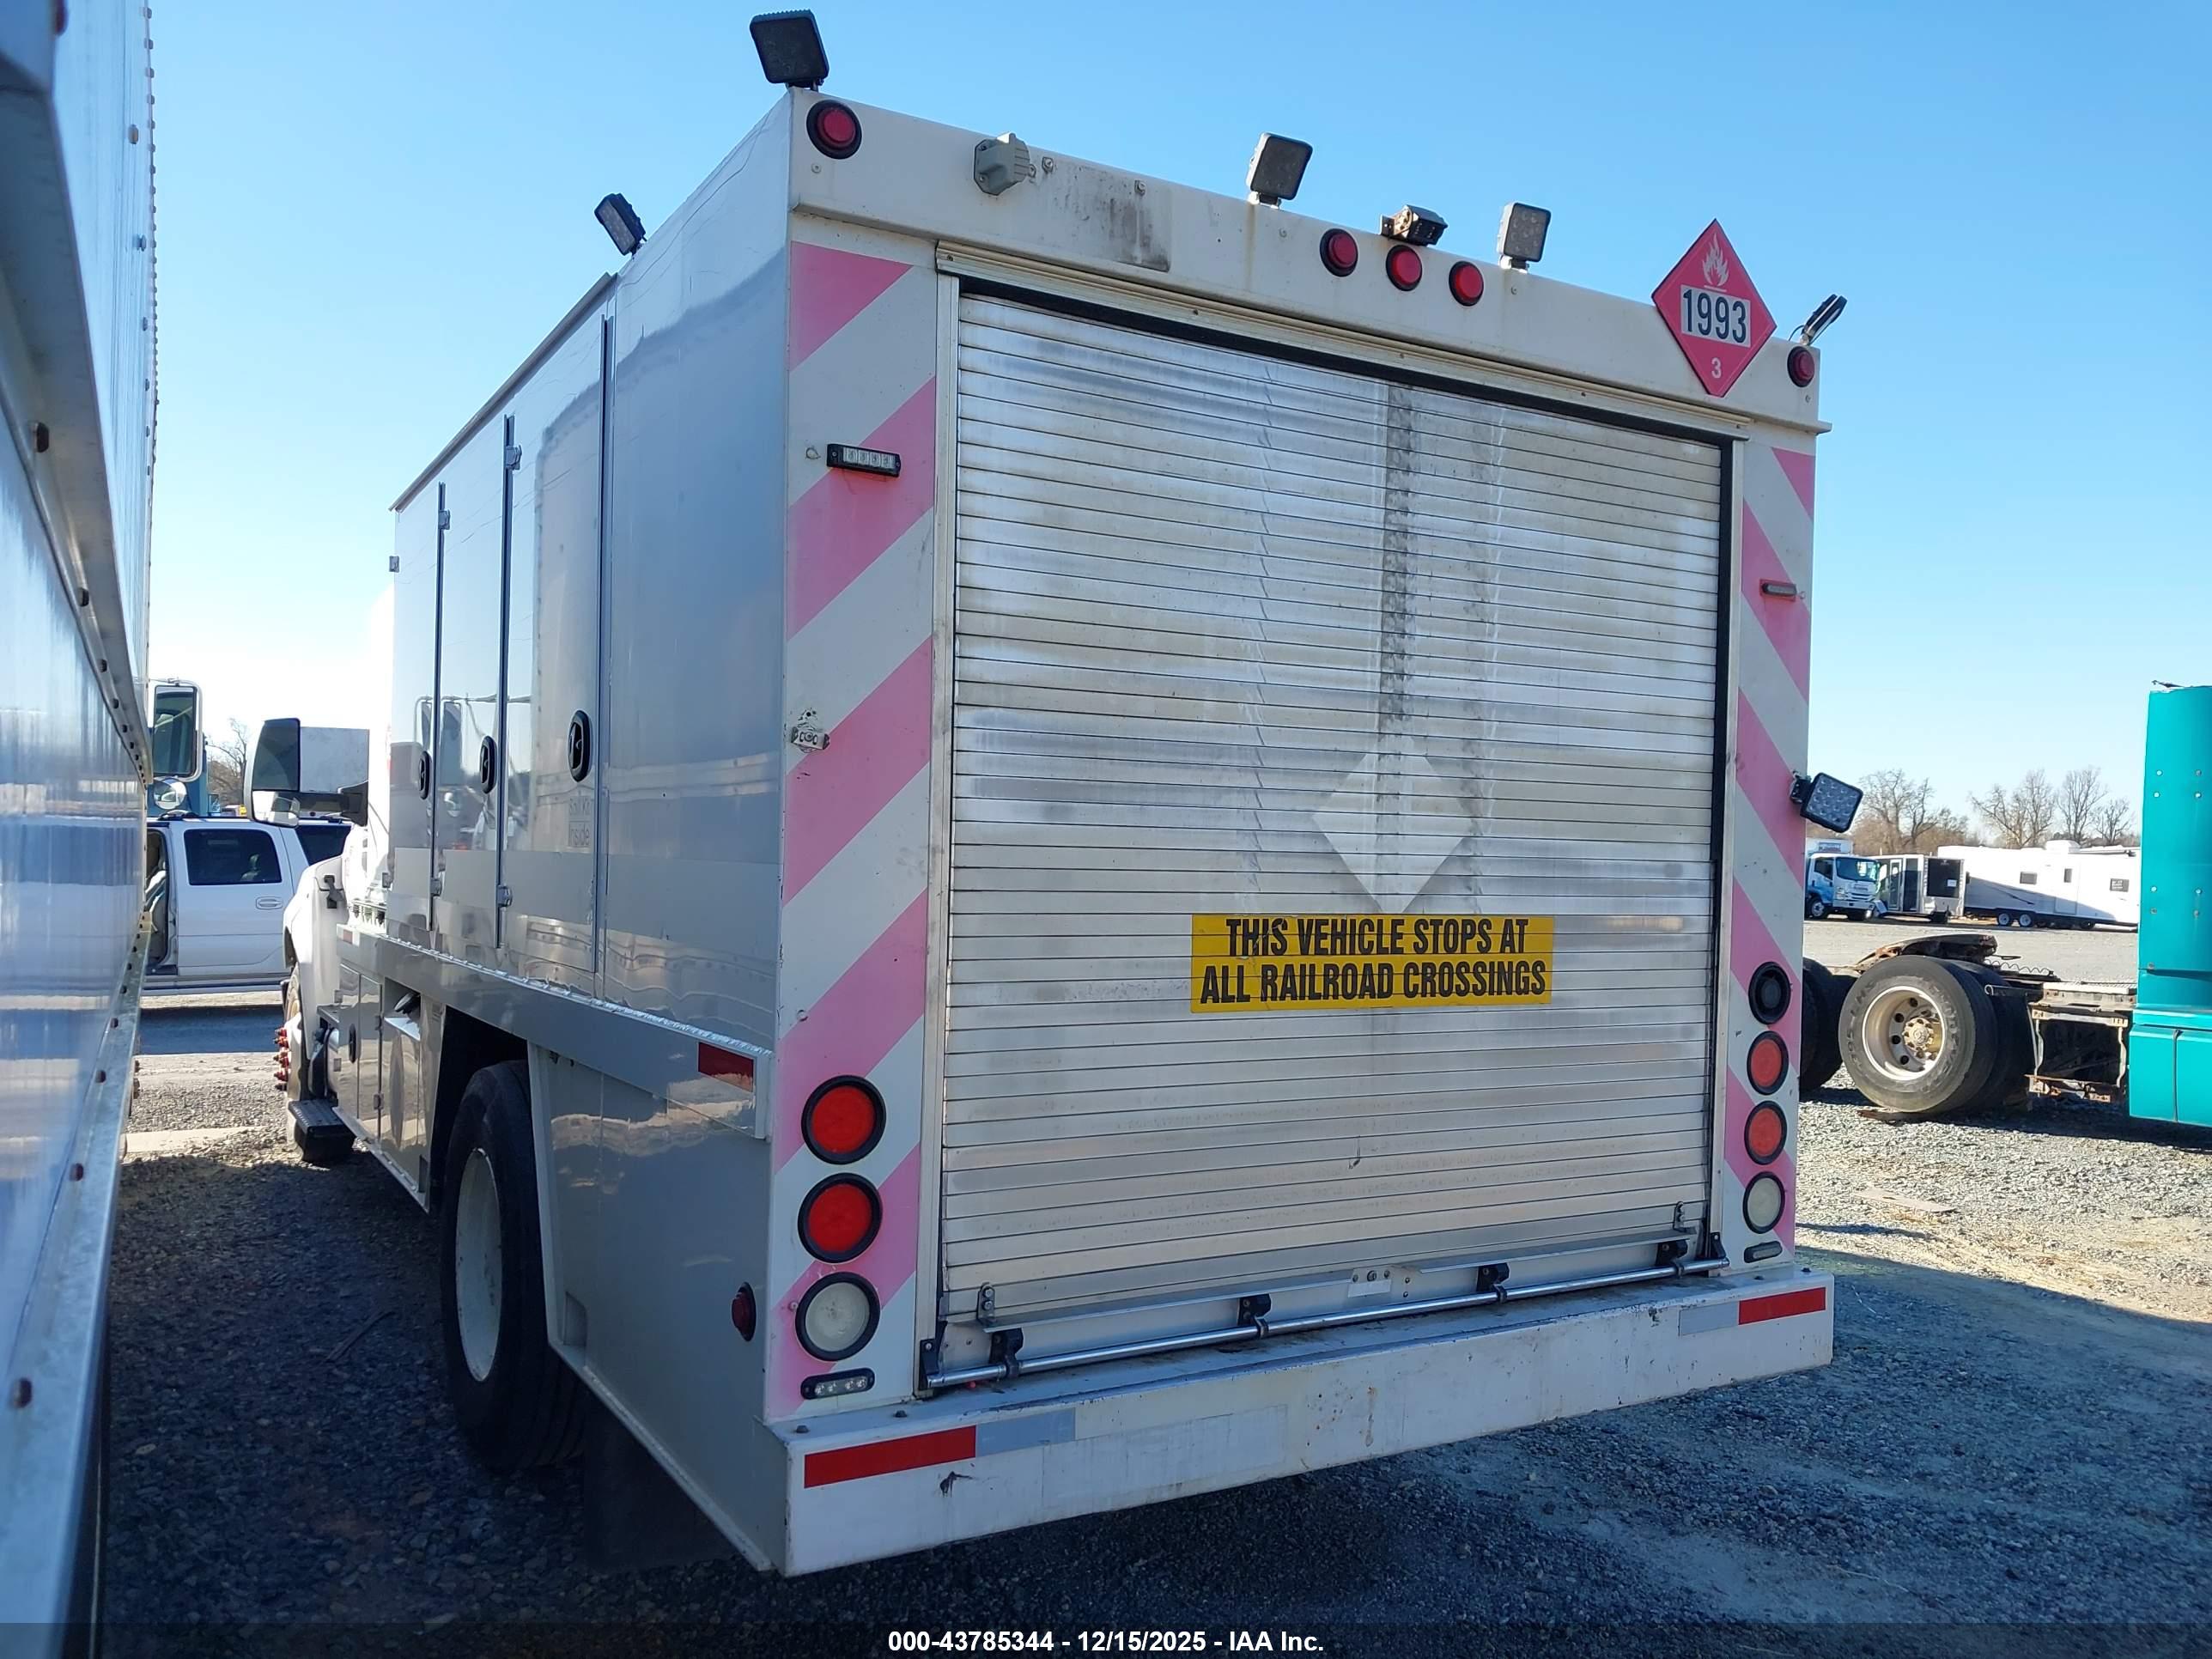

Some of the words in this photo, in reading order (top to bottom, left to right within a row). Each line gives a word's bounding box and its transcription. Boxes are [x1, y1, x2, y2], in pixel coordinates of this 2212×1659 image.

[1683, 289, 1747, 343] 1993
[1711, 357, 1722, 379] 3
[1226, 918, 1287, 957] THIS
[1297, 918, 1405, 956] VEHICLE
[1413, 918, 1492, 954] STOPS
[1500, 918, 1528, 953] AT
[1200, 964, 1250, 1003] ALL
[1261, 962, 1394, 1001] RAILROAD
[1403, 960, 1547, 999] CROSSINGS
